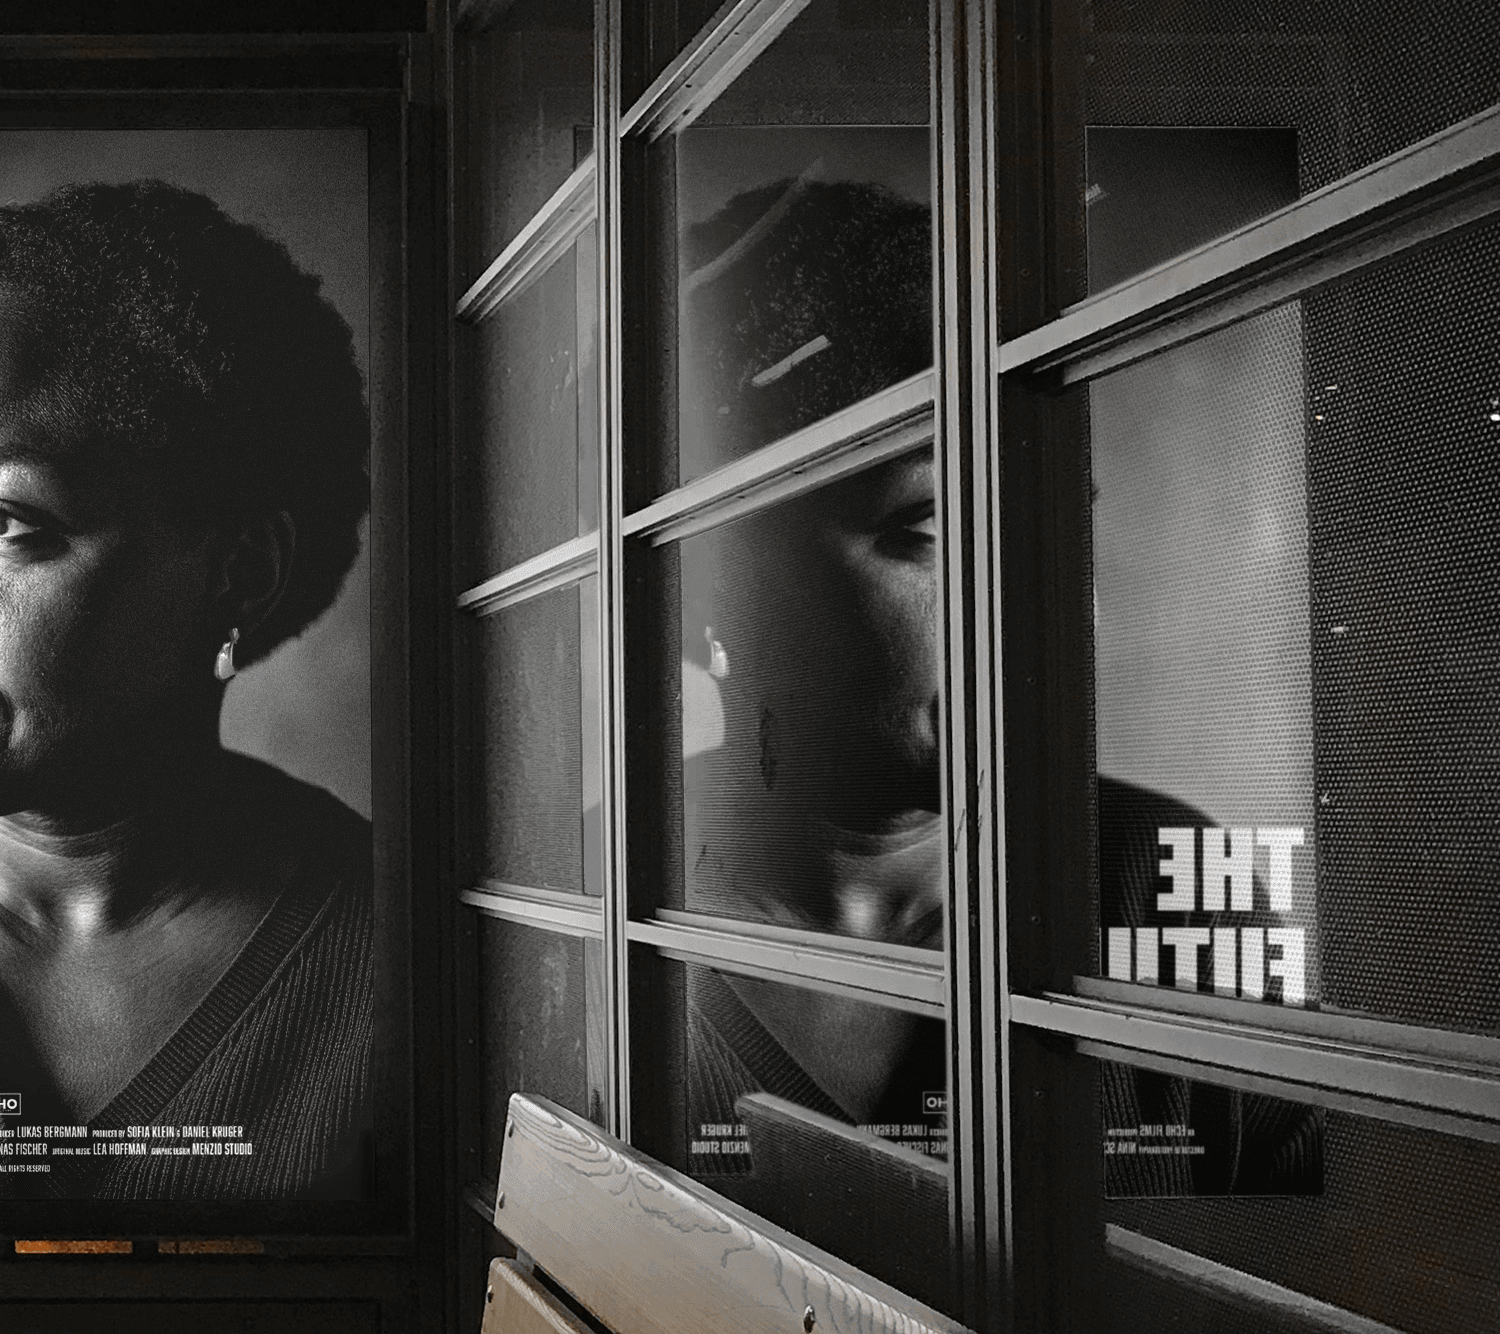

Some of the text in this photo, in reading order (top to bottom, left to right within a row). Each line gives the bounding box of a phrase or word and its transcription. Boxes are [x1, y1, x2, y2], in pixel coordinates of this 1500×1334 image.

[17, 1126, 42, 1138] LUKAS
[44, 1126, 88, 1138] BERGMANN
[118, 1130, 125, 1138] BY
[127, 1126, 150, 1138] SOFIA
[152, 1126, 175, 1138] KLEIN
[183, 1126, 210, 1138] DANIEL
[212, 1126, 243, 1138] KRUGER
[16, 1143, 48, 1155] FISCHER
[93, 1143, 107, 1155] LEA
[109, 1143, 147, 1155] HOFFMAN
[192, 1143, 222, 1155] MENZIO
[225, 1143, 253, 1155] STUDIO
[9, 1165, 26, 1173] RIGHTS
[27, 1165, 51, 1173] RESERVED
